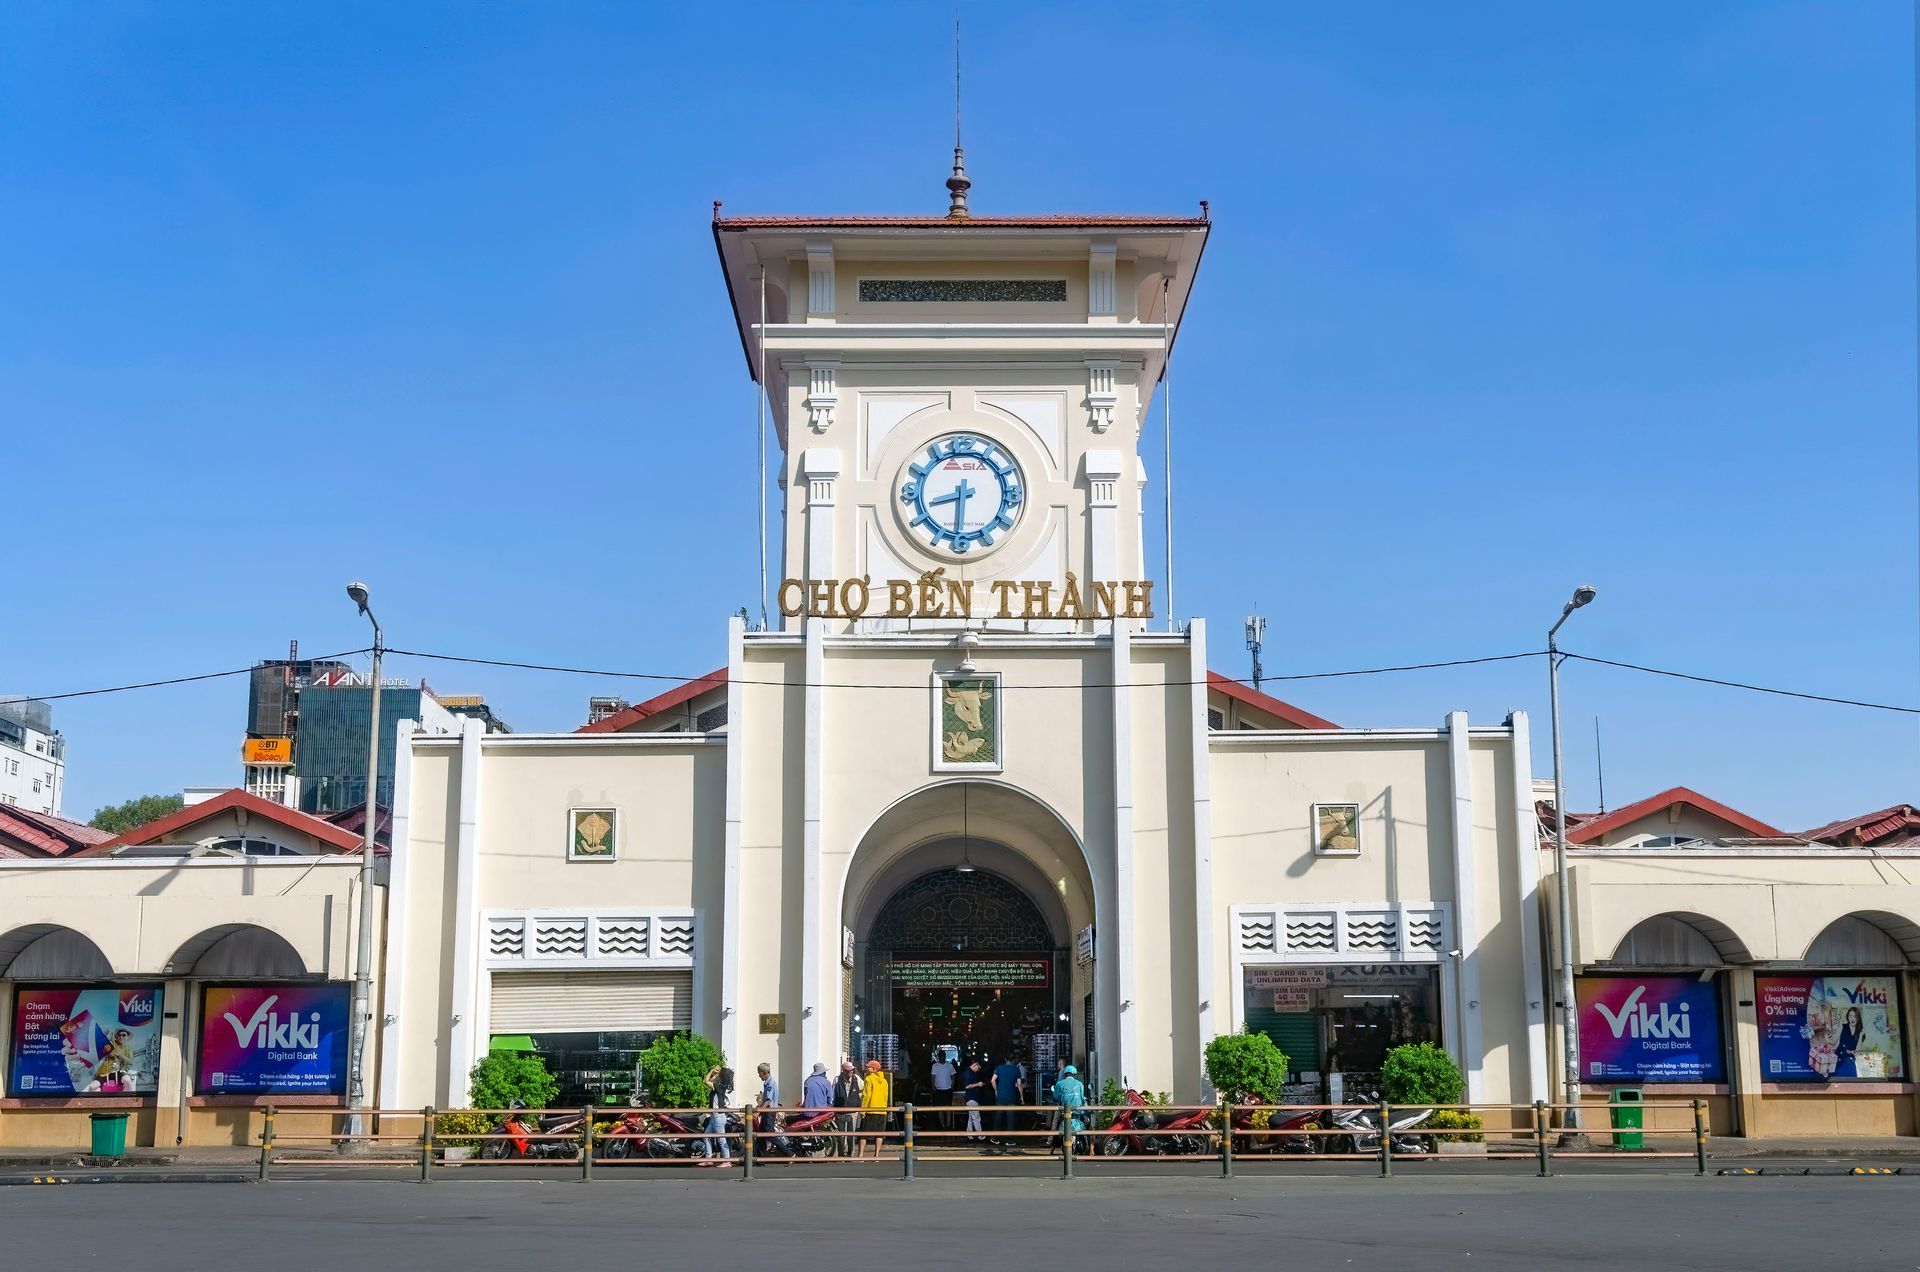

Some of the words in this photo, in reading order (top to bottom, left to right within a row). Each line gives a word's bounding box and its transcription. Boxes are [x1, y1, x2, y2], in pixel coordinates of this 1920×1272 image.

[952, 436, 977, 453] 12
[943, 458, 987, 470] ASIA
[902, 482, 919, 499] 9
[954, 534, 970, 552] 6
[778, 574, 870, 622] CHỢ
[886, 567, 975, 618] BẾN
[991, 571, 1154, 618] THÀNH
[313, 672, 373, 687] AVANT
[381, 678, 411, 686] HOTEL
[1842, 979, 1887, 1004] Vikki
[26, 1002, 50, 1011] Chạm
[120, 994, 152, 1013] Vikki
[1765, 1005, 1784, 1015] 0%
[1786, 1007, 1797, 1015] lãi
[26, 1012, 43, 1020] cảm
[1594, 985, 1691, 1038] Vikki
[25, 1022, 40, 1032] Bật
[223, 995, 320, 1049] Vikki
[25, 1033, 48, 1041] tương
[50, 1032, 60, 1040] lai
[1642, 1041, 1669, 1051] Digital
[1671, 1041, 1692, 1049] Bank
[268, 1051, 295, 1061] Digital
[297, 1051, 318, 1060] Bank
